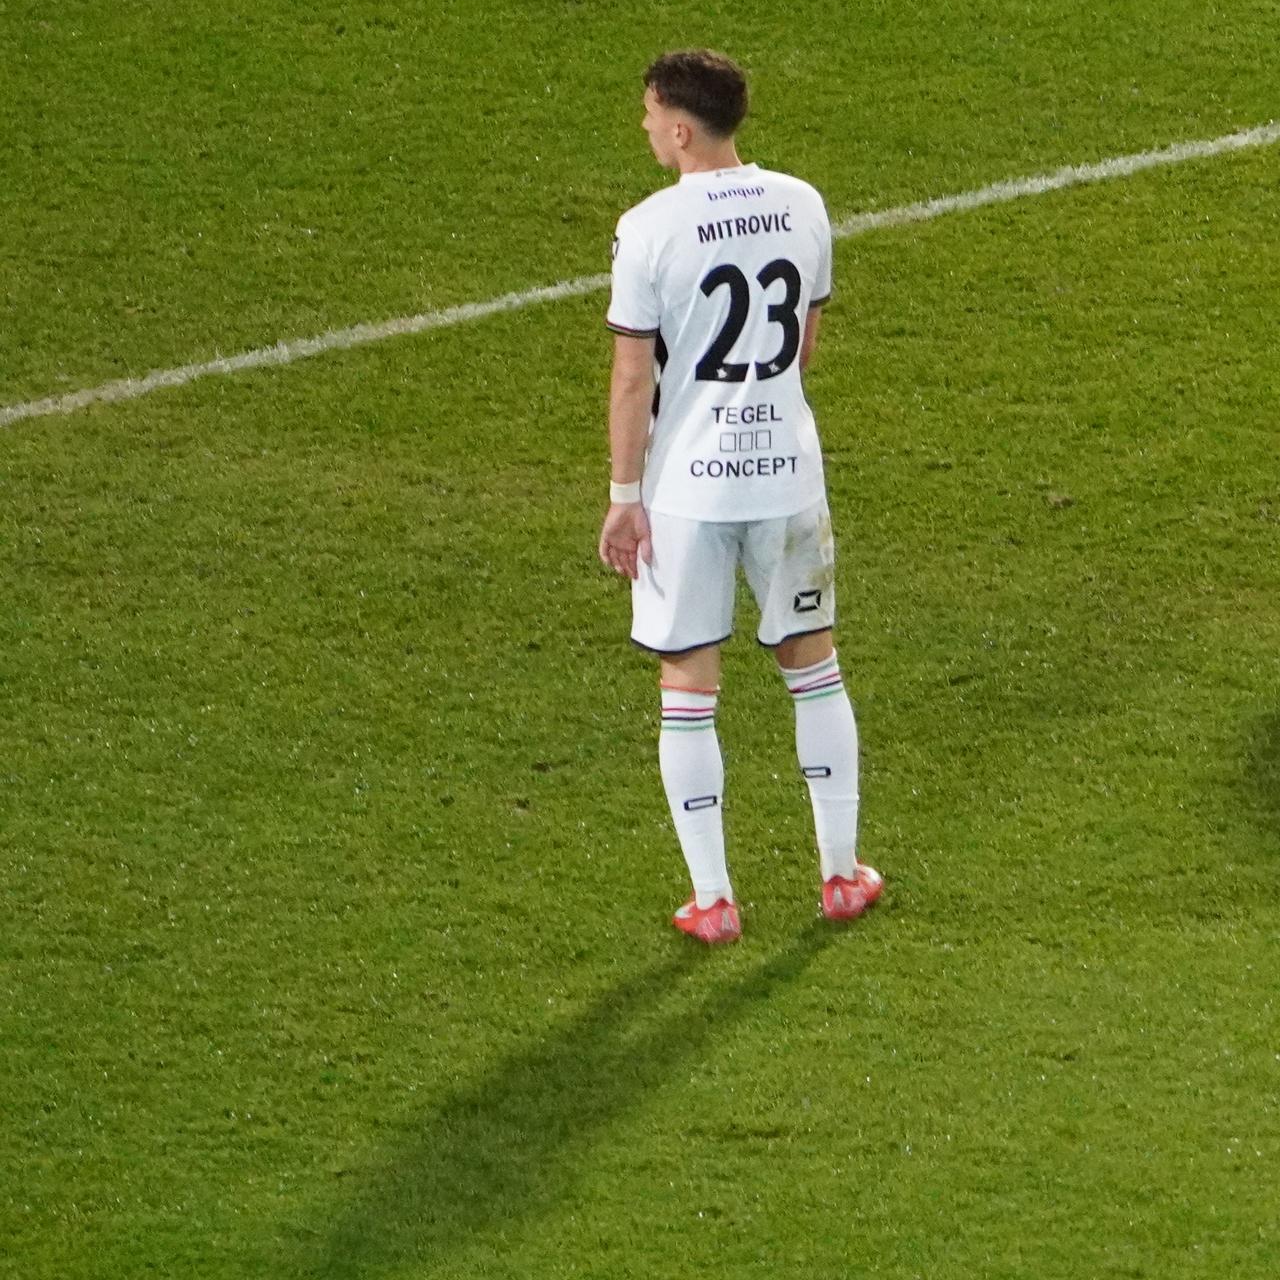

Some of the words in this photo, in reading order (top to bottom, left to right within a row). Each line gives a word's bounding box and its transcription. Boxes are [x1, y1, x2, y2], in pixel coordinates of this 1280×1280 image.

[706, 185, 765, 202] banqup
[696, 205, 793, 244] MITROVIĆ
[694, 258, 802, 382] 23
[711, 404, 783, 425] TEGEL
[690, 456, 798, 479] CONCEPT
